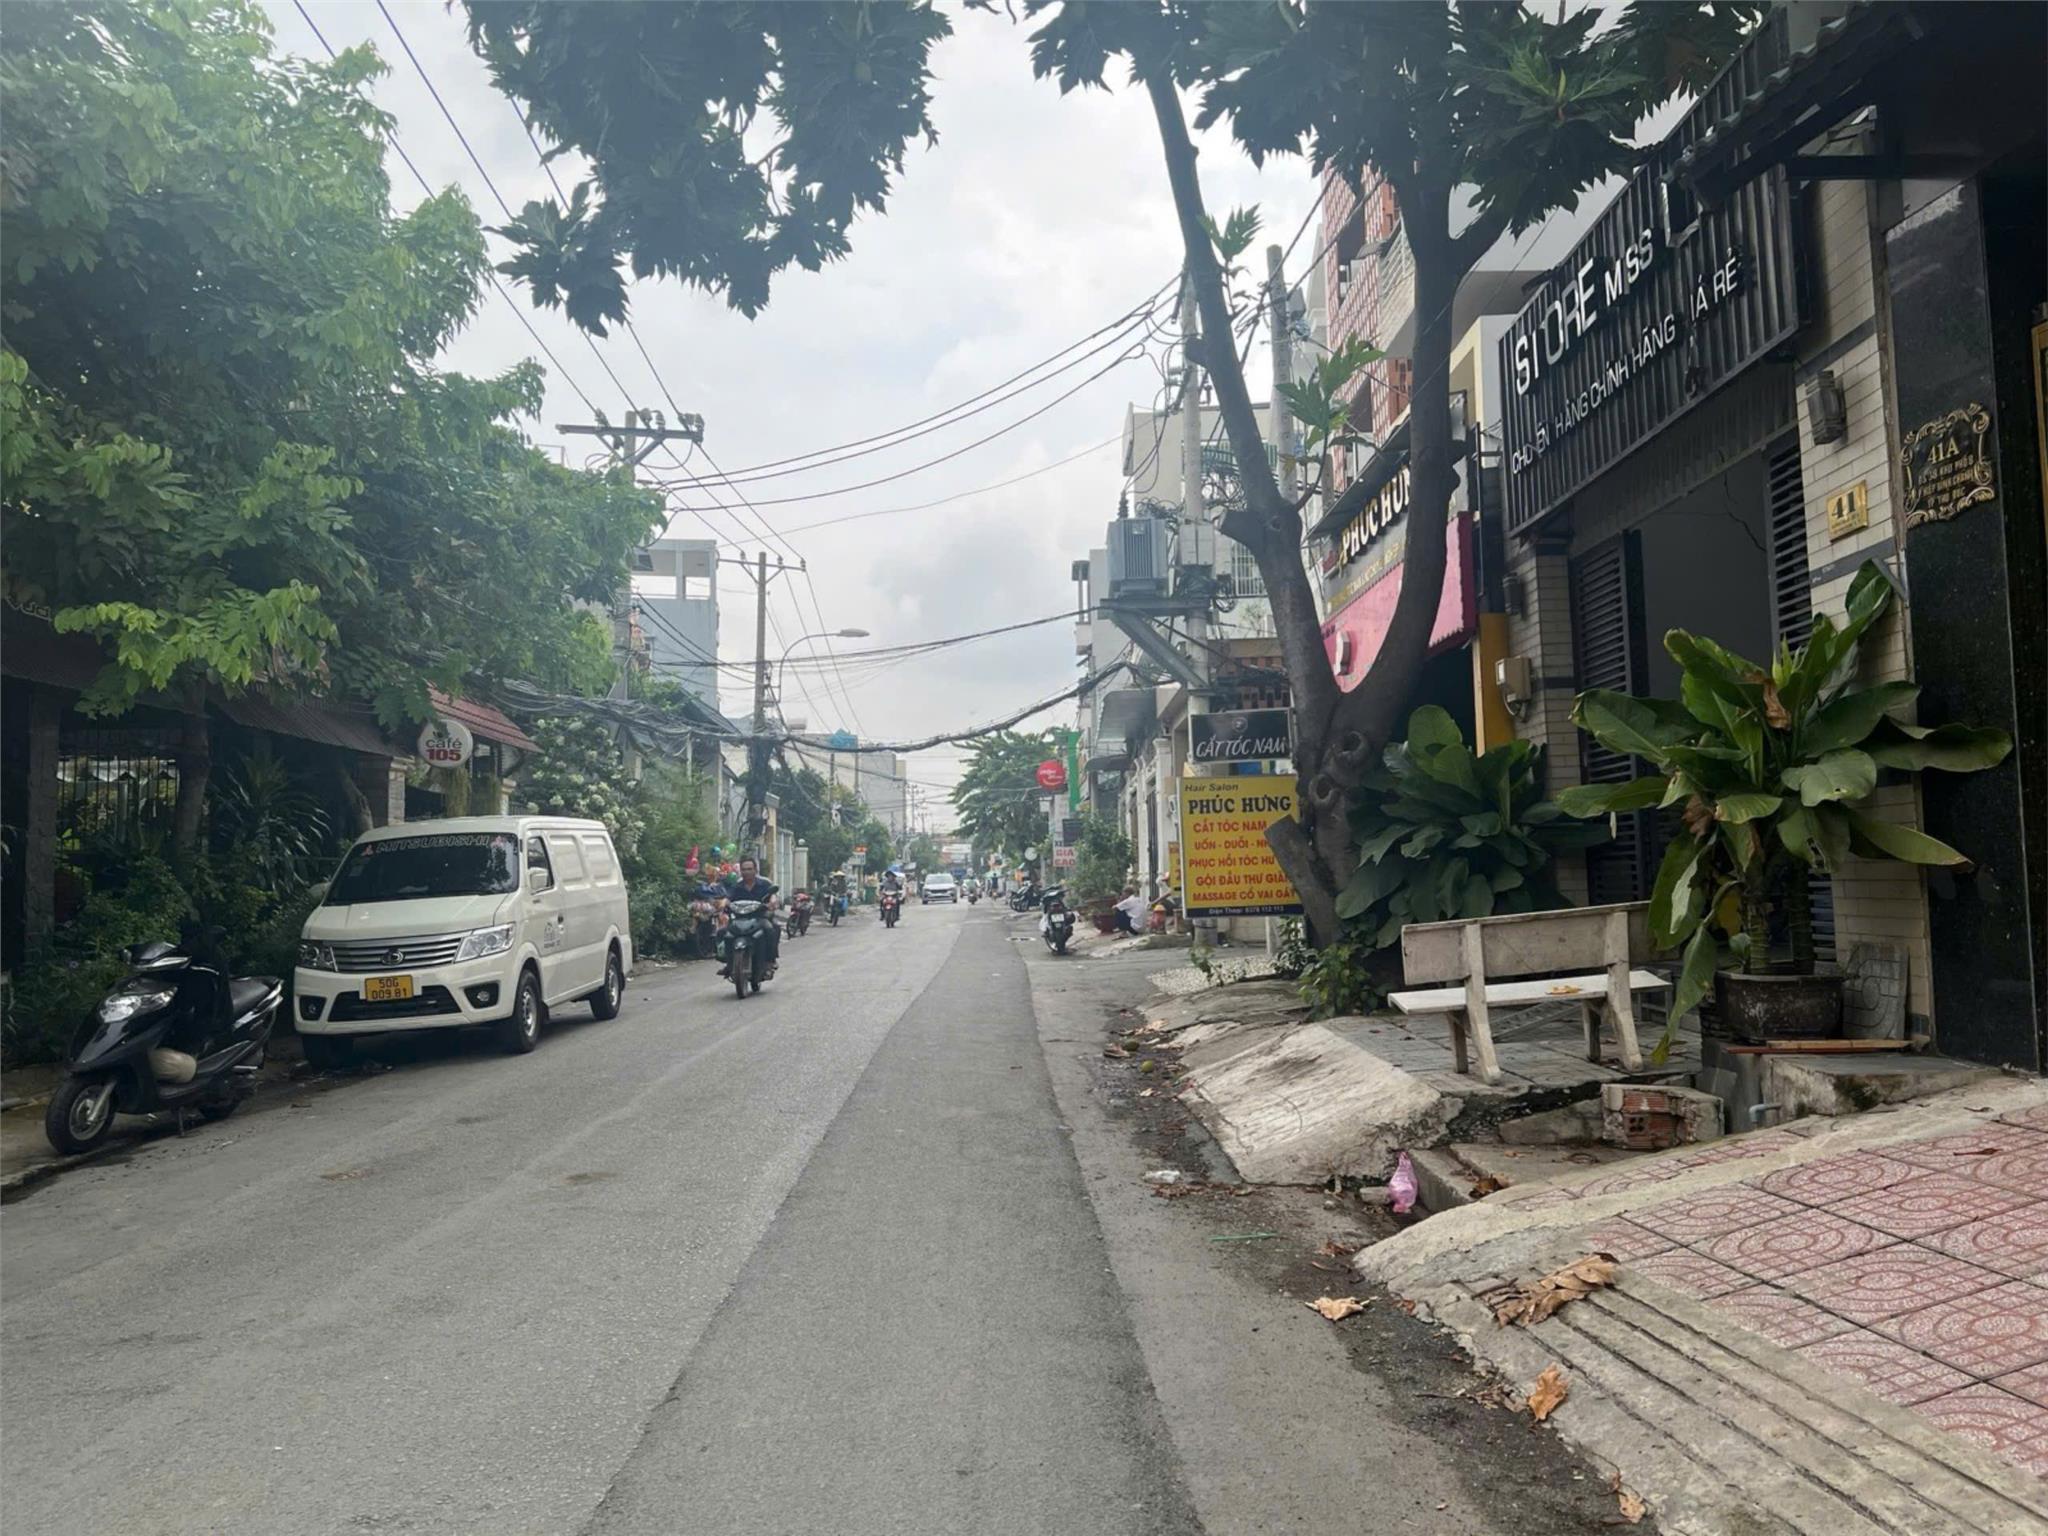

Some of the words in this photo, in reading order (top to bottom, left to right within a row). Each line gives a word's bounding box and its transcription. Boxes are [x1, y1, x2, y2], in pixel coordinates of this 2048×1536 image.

[1928, 436, 1960, 465] 41A
[1831, 491, 1856, 519] 41
[426, 748, 461, 761] 105
[1188, 794, 1235, 814] PHÚC
[1241, 795, 1292, 813] HƯNG
